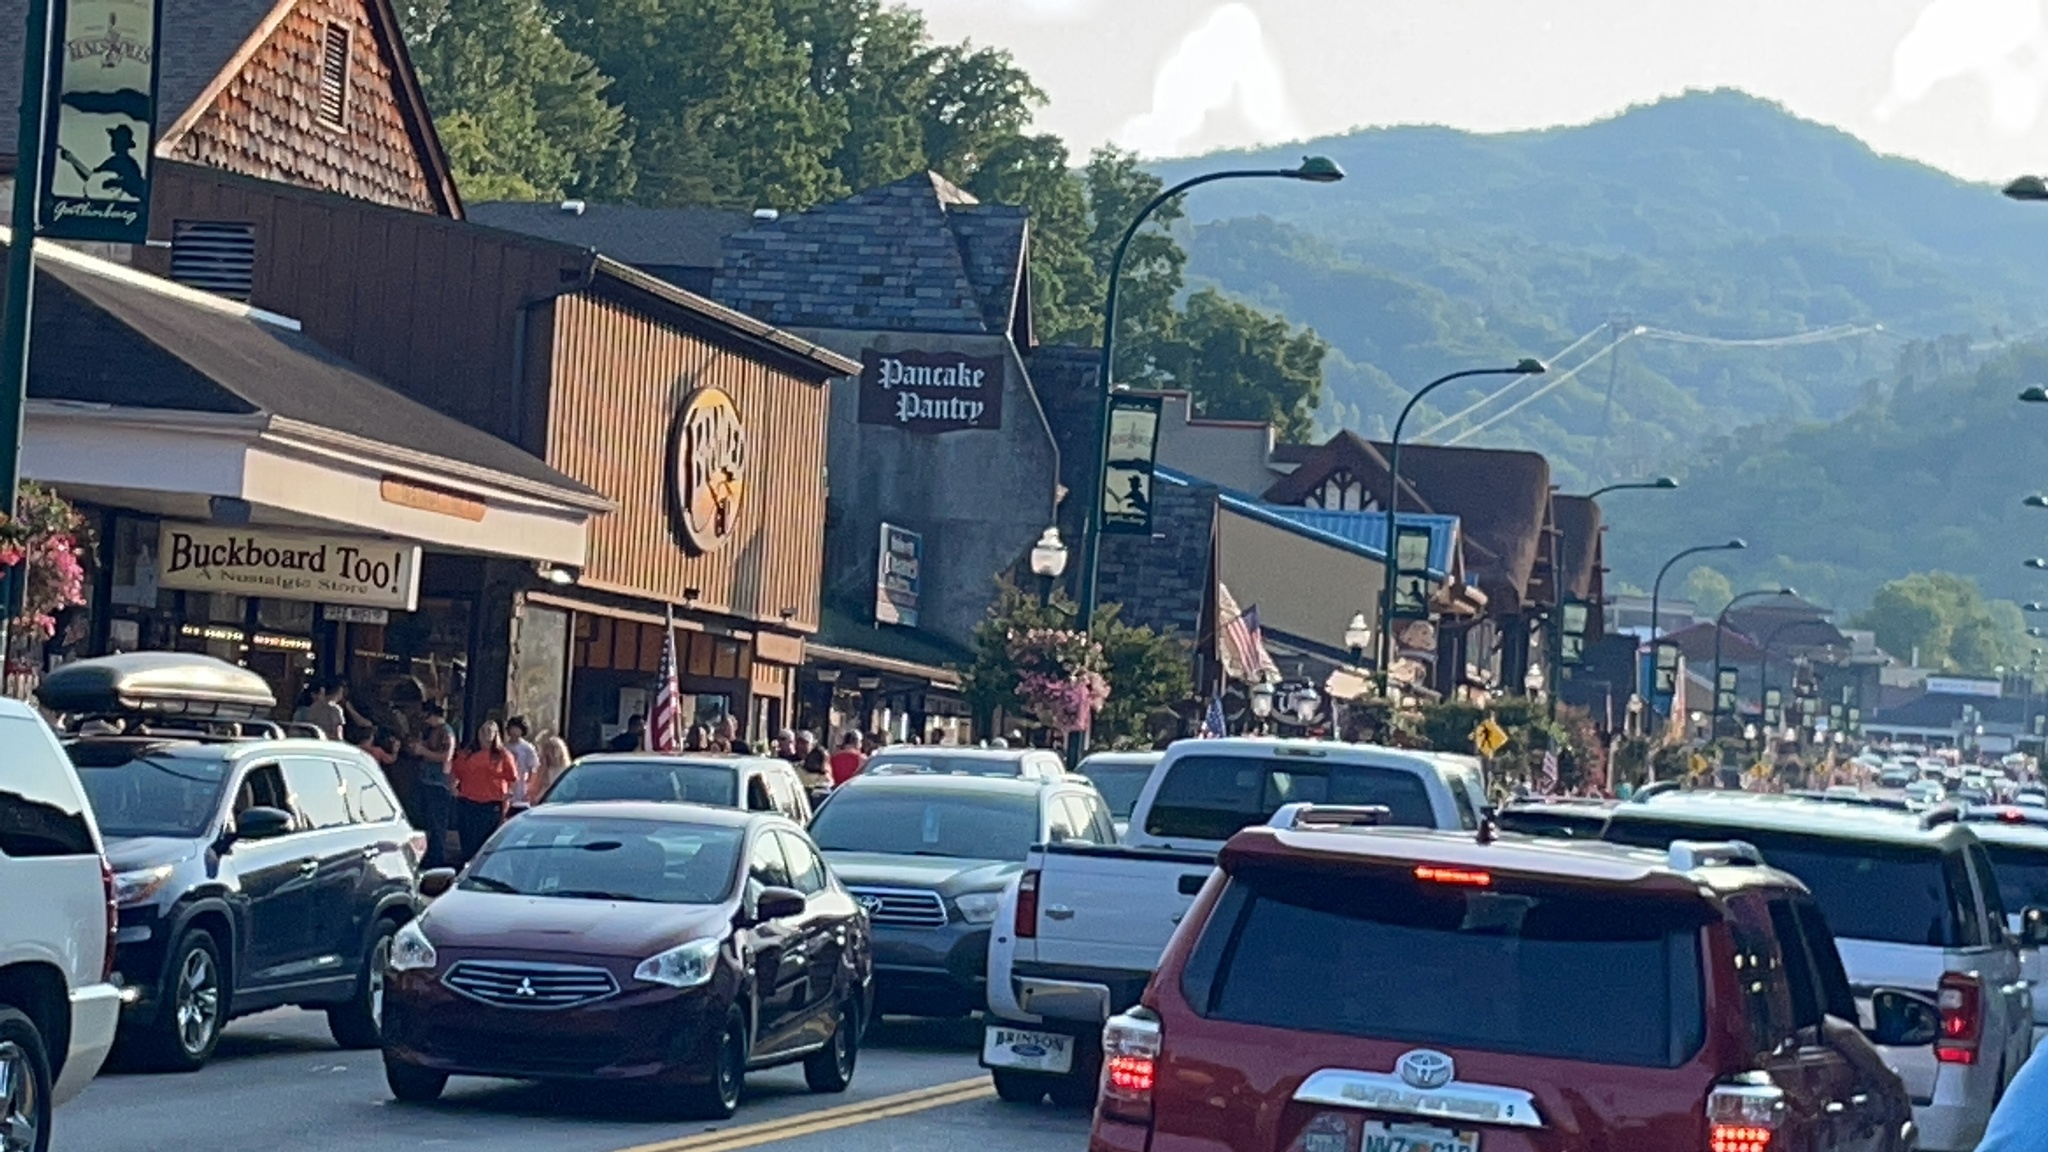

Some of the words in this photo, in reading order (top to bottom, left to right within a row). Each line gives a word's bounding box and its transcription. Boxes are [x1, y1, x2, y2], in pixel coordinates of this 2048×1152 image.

[53, 201, 137, 225] Gatlinburg
[877, 358, 985, 389] Pancake
[895, 391, 984, 425] Pantry
[167, 533, 327, 573] Buckboard
[336, 547, 401, 594] Too!
[196, 567, 213, 581] A
[220, 569, 312, 590] Nostalgic
[317, 579, 370, 595] Store
